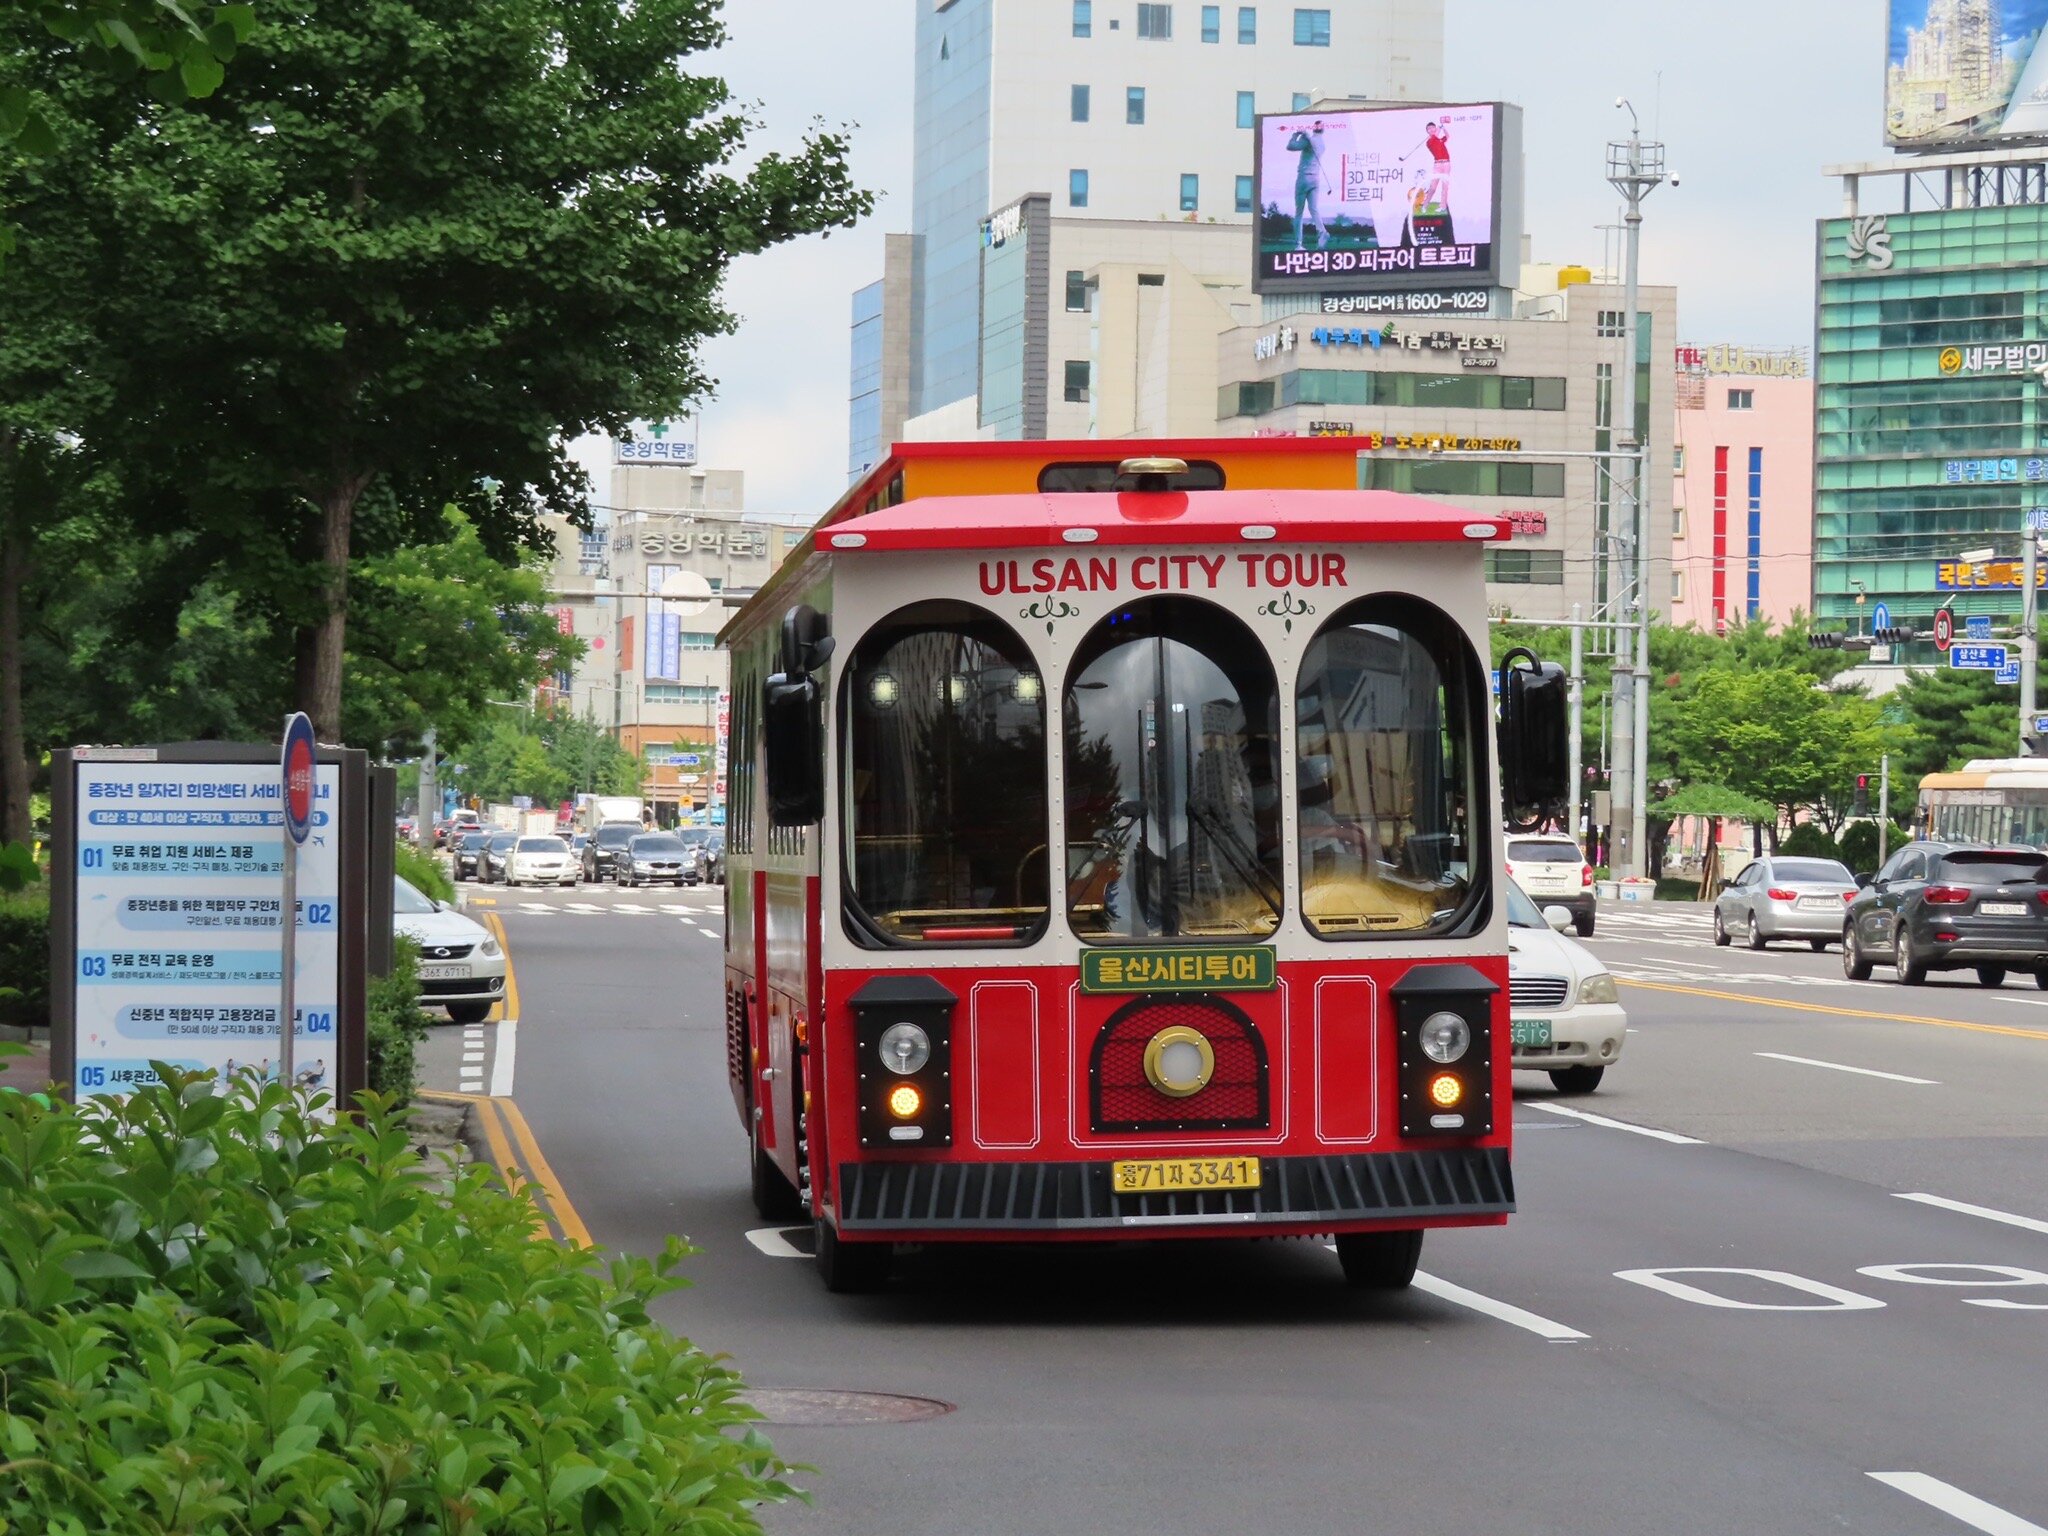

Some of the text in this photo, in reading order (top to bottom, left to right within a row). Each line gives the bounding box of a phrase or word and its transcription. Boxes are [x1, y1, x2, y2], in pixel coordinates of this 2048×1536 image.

[1347, 152, 1380, 167] 나만의
[1347, 168, 1403, 185] 3D 피규어
[1347, 187, 1383, 202] 트로피
[1274, 246, 1475, 274] 나만의 3D 피규어 트로피
[1323, 295, 1396, 313] 경상미디어
[1406, 292, 1488, 310] 1600-1029
[1311, 327, 1383, 349] 세무회계
[1391, 329, 1422, 350] 키움
[1962, 344, 2047, 371] 세무법인
[621, 441, 687, 459] 중앙학문
[1945, 458, 2018, 482] 법무법인
[640, 530, 752, 556] 중앙학문
[979, 553, 1348, 595] ULSAN CITY TOUR
[1937, 620, 1948, 640] 60
[1959, 648, 1988, 660] 삼산로
[89, 783, 134, 799] 중장년
[138, 783, 182, 799] 일자리
[187, 783, 247, 799] 희망센터
[251, 783, 281, 799] 서비
[97, 812, 118, 824] 대상
[127, 812, 138, 824] 만
[166, 812, 187, 824] 이상
[83, 847, 103, 868] 01
[112, 845, 254, 858] 무료 취업 지원 서비스 제공
[128, 899, 178, 912] 중장년층을
[182, 899, 203, 912] 위한
[205, 899, 246, 912] 적합직무
[249, 899, 280, 912] 구인처
[308, 903, 332, 924] 02
[225, 916, 241, 926] 무료
[82, 956, 106, 976] 03
[112, 954, 215, 967] 무료 전직 교육 운영
[1099, 955, 1256, 983] 울산시티투어
[444, 967, 466, 977] 6711
[130, 1008, 165, 1021] 신중년
[168, 1008, 215, 1021] 적합직무
[218, 1008, 276, 1021] 고용장려금
[308, 1012, 332, 1033] 04
[202, 1024, 219, 1035] 이상
[81, 1066, 105, 1086] 05
[1189, 1161, 1248, 1185] 3341
